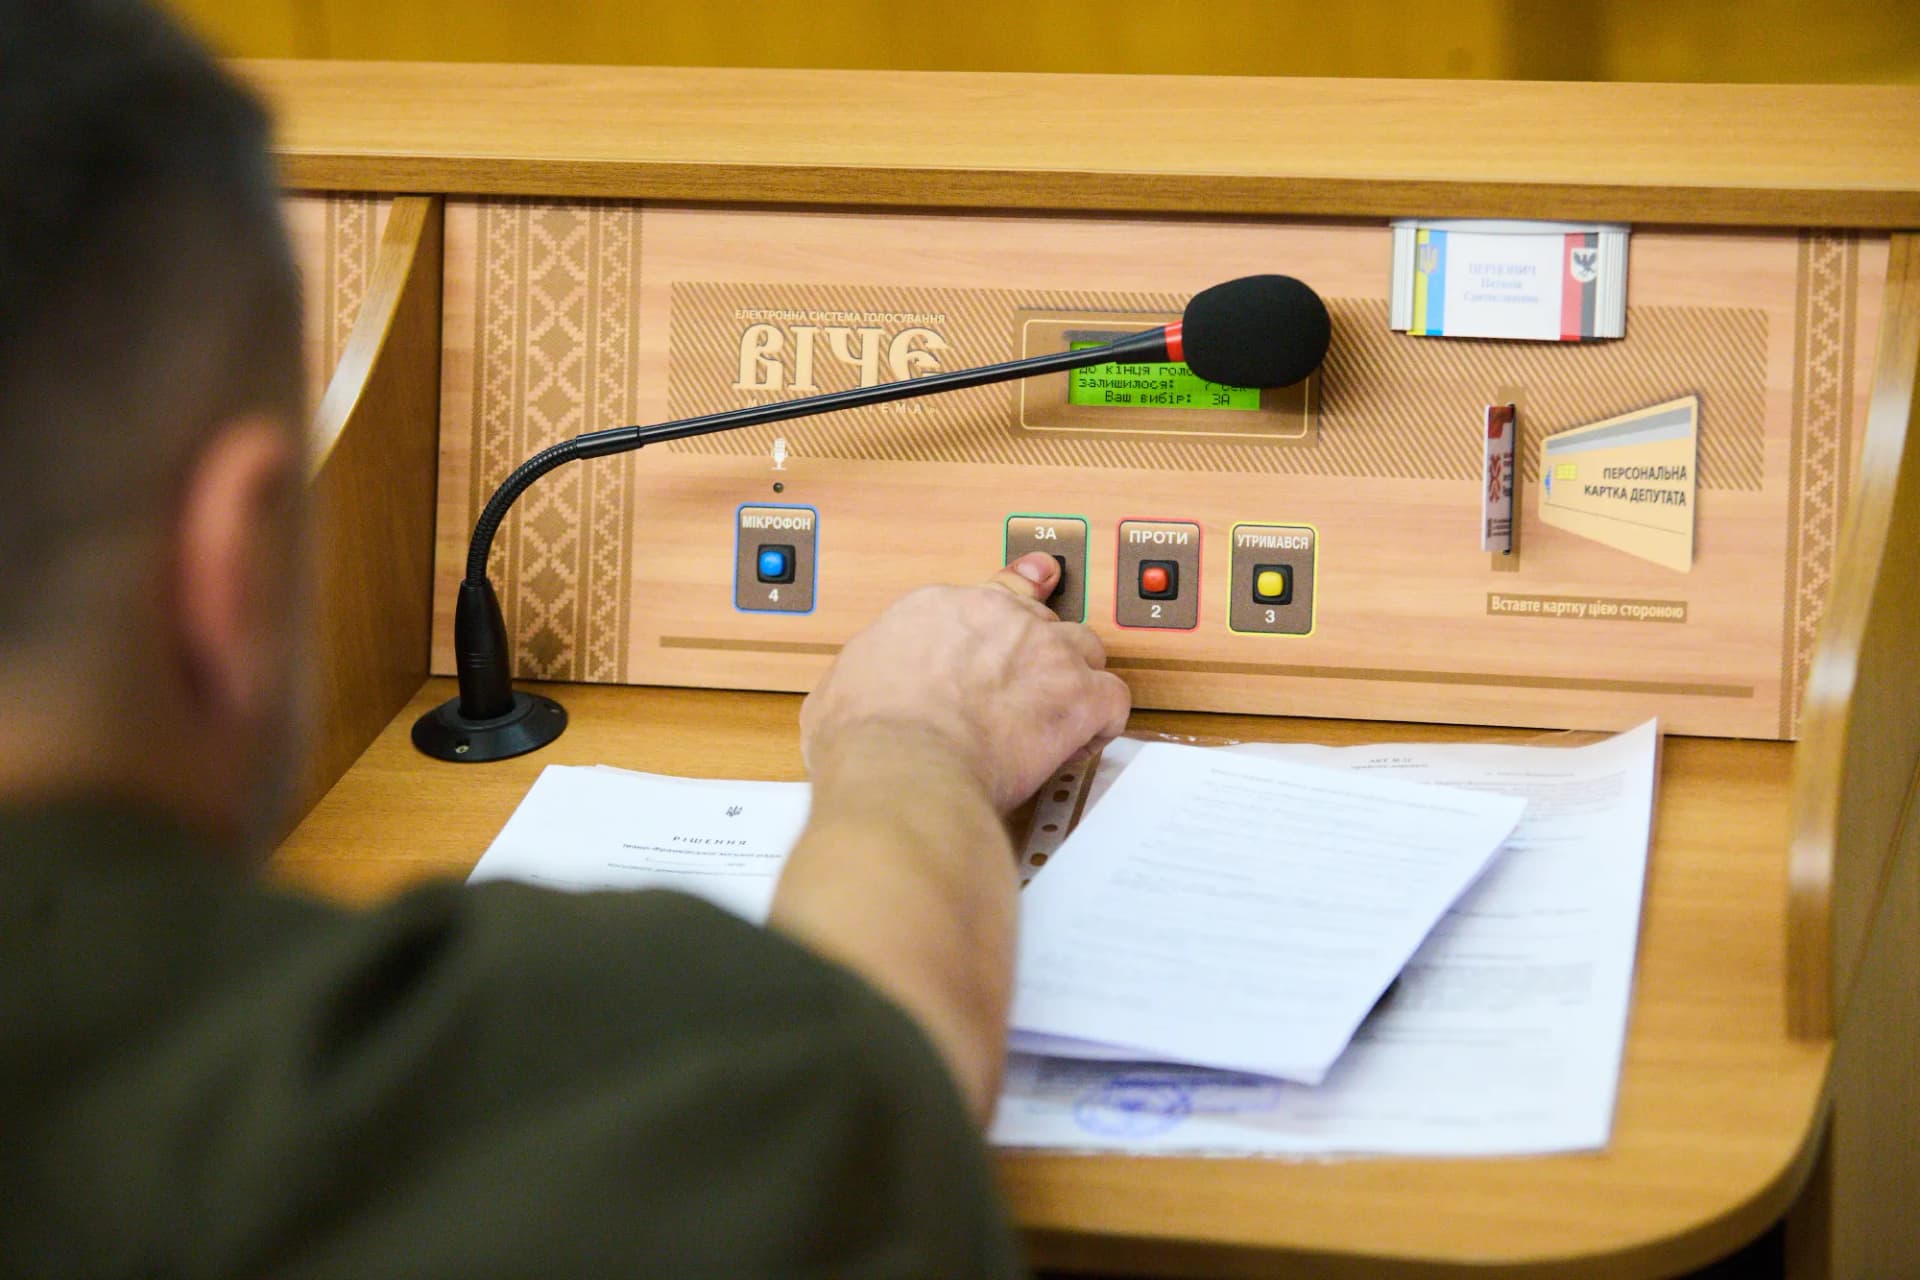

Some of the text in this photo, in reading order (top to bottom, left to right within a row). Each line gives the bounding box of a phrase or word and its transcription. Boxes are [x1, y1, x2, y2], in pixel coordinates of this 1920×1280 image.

[736, 309, 945, 325] ЕЛЕКТРОННА СИСТЕМА ГОЛОСУВАННЯ
[1105, 365, 1150, 376] кінця
[1078, 378, 1174, 390] залишилося:
[1105, 390, 1230, 406] Ваш вибір: ЗА
[1602, 465, 1687, 481] ПЕРСОНАЛЬНА
[1583, 484, 1687, 507] КАРТКА ДЕПУТАТА
[742, 514, 811, 531] МІКРОФОН
[1034, 527, 1057, 541] ЗА
[1128, 530, 1188, 545] ПРОТИ
[1237, 533, 1309, 550] УТРИМАВСЯ
[768, 588, 779, 602] 4
[1151, 605, 1161, 618] 2
[1491, 596, 1684, 620] Вставте картку цією стороною
[1264, 609, 1275, 623] 3
